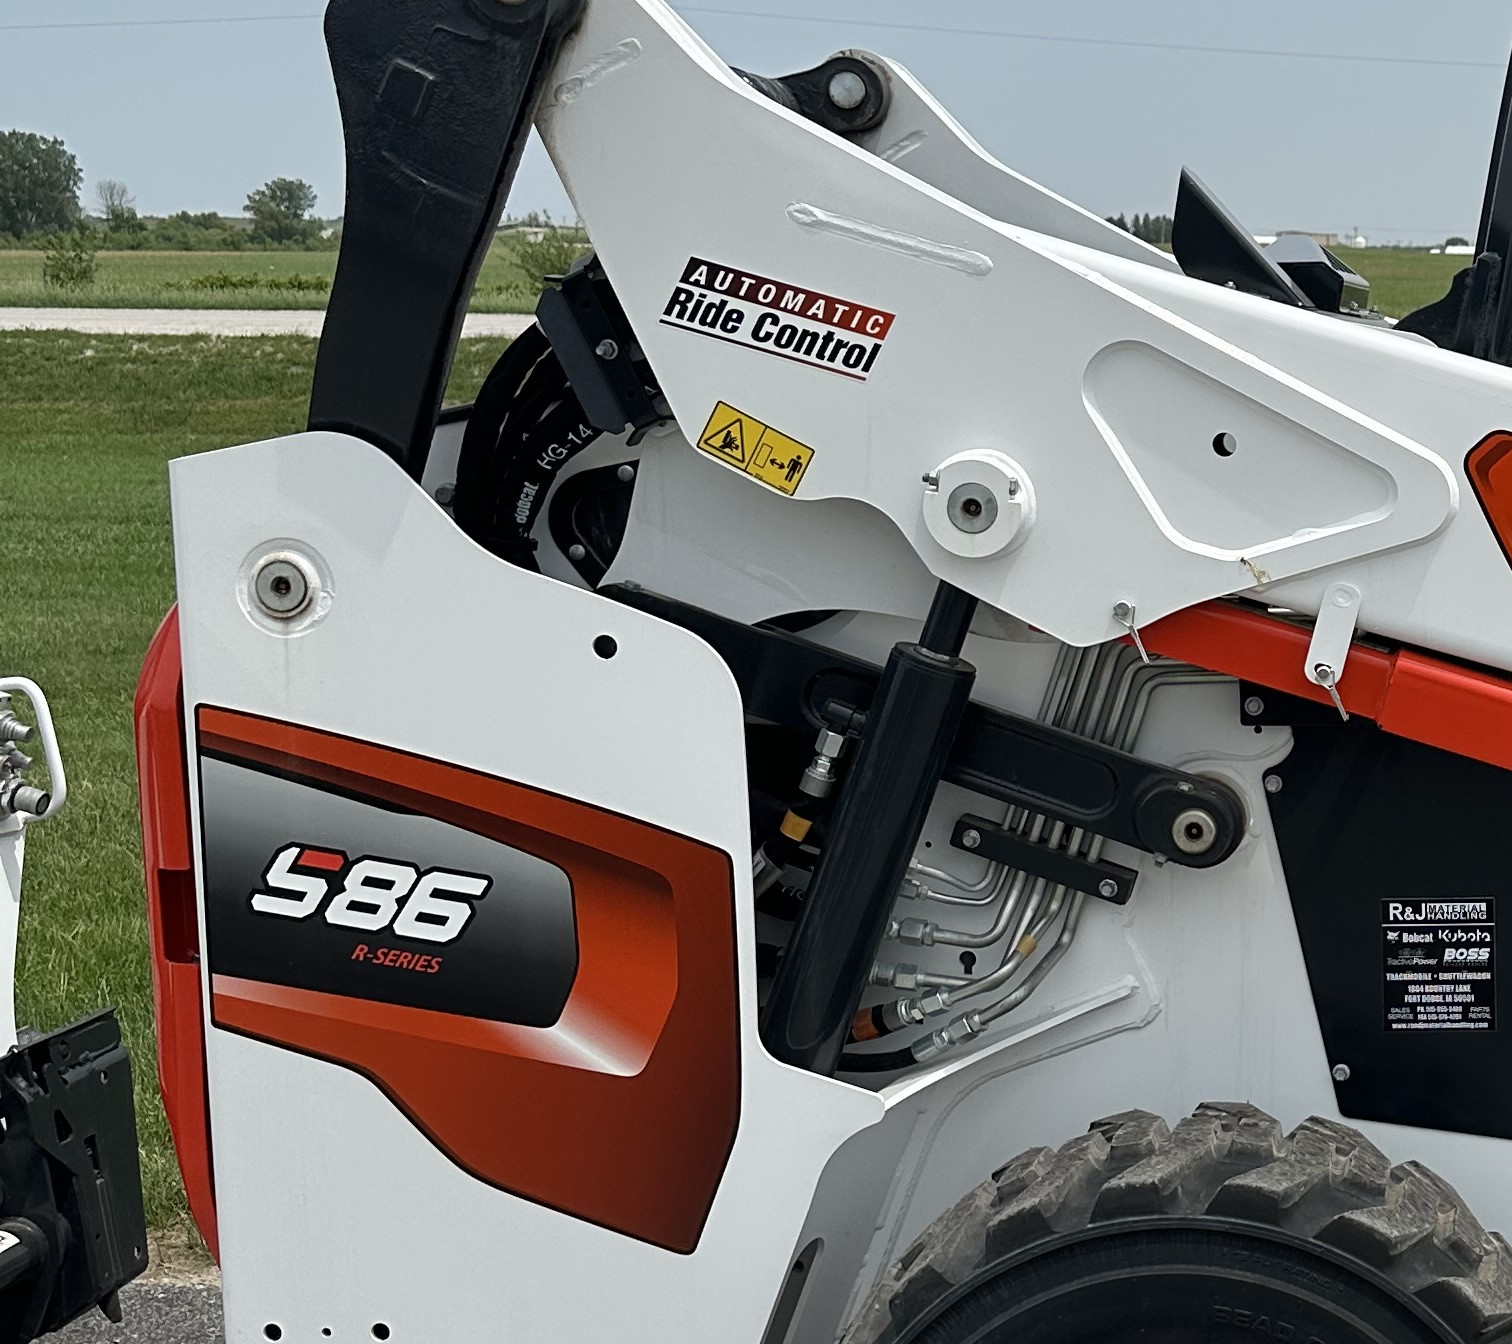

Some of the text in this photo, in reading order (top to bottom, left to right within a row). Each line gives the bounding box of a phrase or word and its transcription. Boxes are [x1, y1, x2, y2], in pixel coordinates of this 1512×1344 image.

[689, 265, 885, 335] AUTOMATIC
[663, 286, 882, 373] Ride Control
[536, 424, 593, 470] HG-14
[251, 846, 488, 943] S86
[1389, 903, 1487, 921] R&J MATERIAL
[1427, 912, 1487, 920] HANDLING
[1402, 929, 1492, 943] Bobcat Kubota
[351, 944, 443, 973] R-SERIES
[1444, 948, 1491, 960] BOSS
